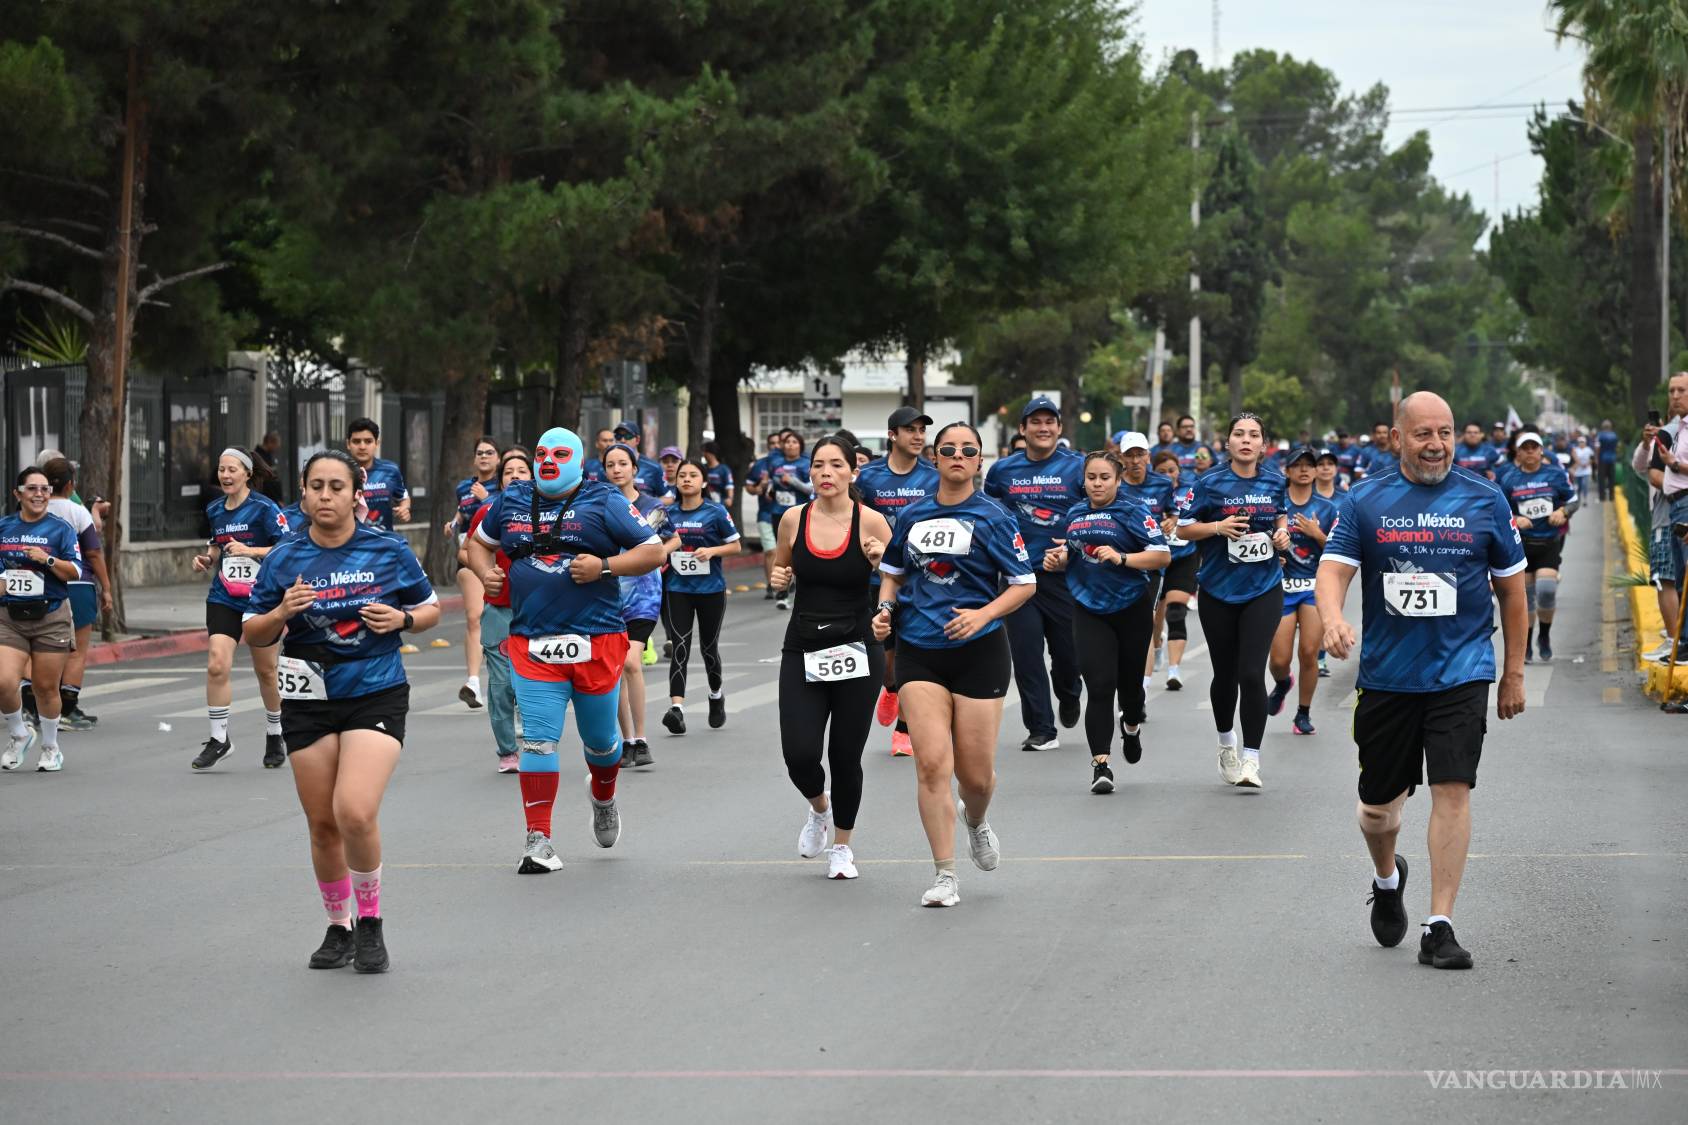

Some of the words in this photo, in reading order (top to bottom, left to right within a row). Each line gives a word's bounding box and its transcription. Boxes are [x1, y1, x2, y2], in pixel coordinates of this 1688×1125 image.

[1033, 476, 1062, 484] México
[876, 489, 896, 498] Todo
[898, 488, 926, 496] México
[1245, 494, 1272, 504] México
[1526, 504, 1547, 516] 496
[1380, 516, 1414, 528] Todo
[1418, 513, 1465, 528] México
[21, 534, 48, 544] México
[920, 531, 955, 548] 481
[1376, 528, 1434, 543] Salvando
[1438, 529, 1474, 543] Vidas
[1239, 542, 1268, 558] 240
[1400, 545, 1411, 554] 5k,
[1414, 546, 1428, 554] 10k
[681, 560, 696, 570] 56
[228, 566, 252, 578] 213
[330, 570, 374, 586] México
[8, 578, 32, 592] 215
[1284, 578, 1312, 590] 305
[1400, 590, 1438, 610] 731
[540, 642, 579, 658] 440
[818, 656, 856, 676] 569
